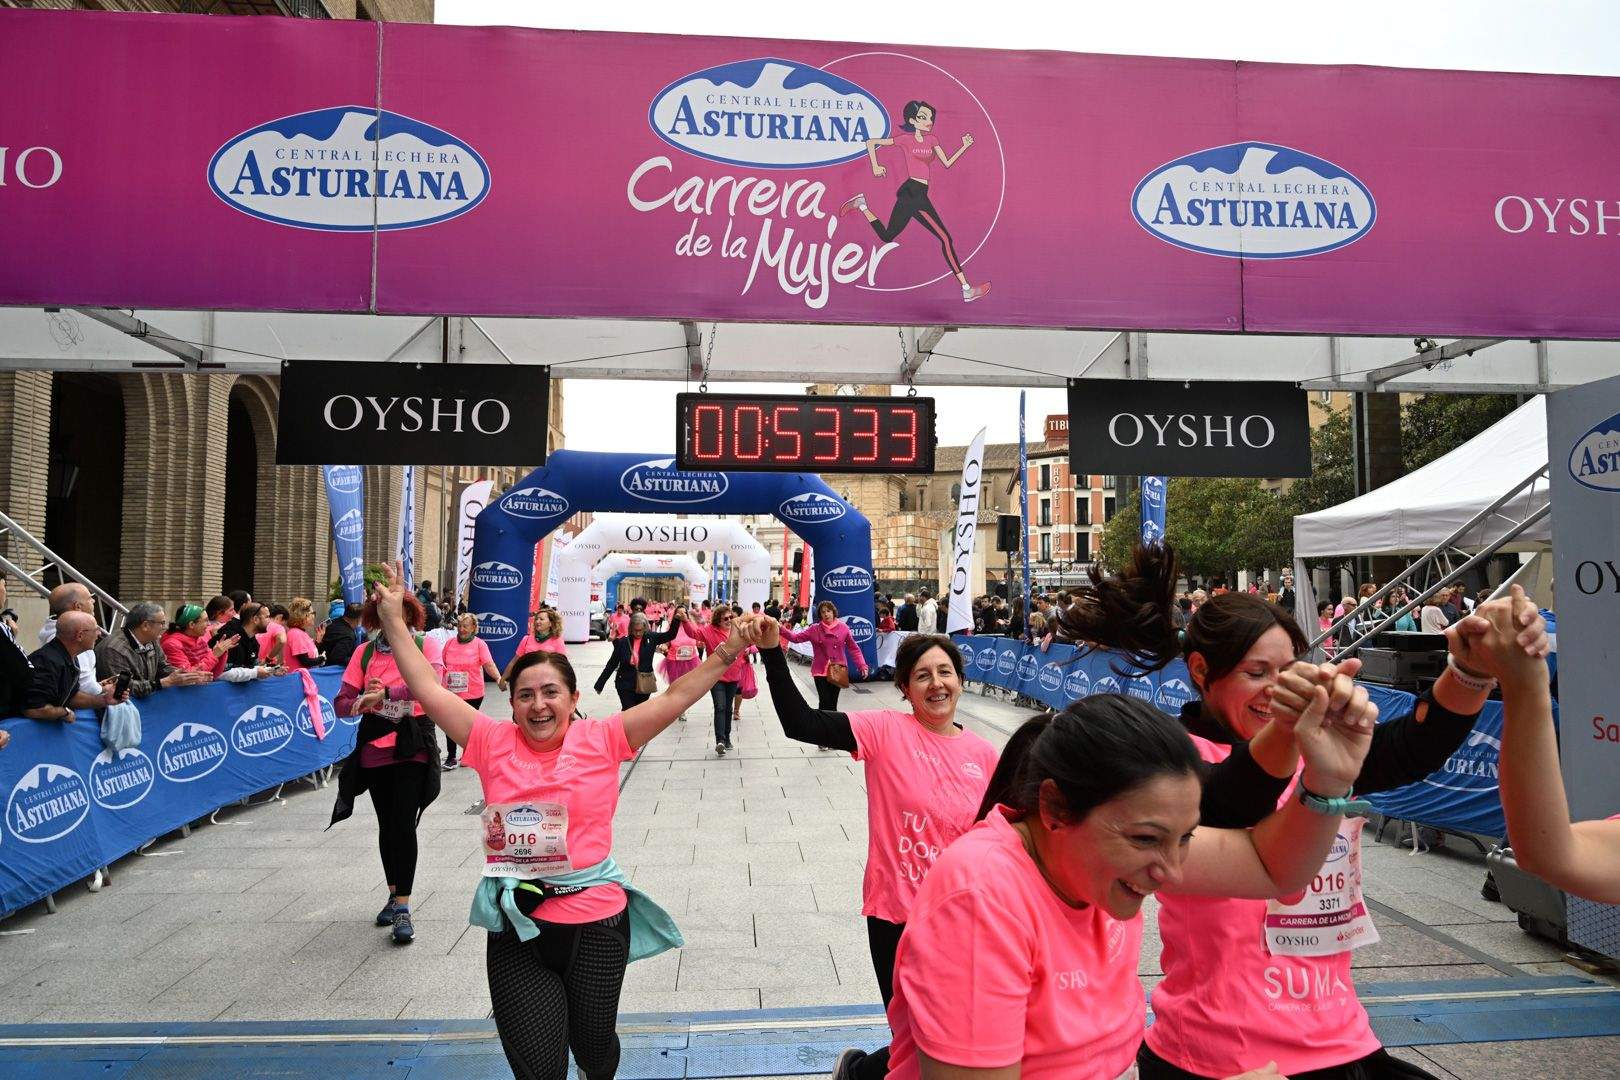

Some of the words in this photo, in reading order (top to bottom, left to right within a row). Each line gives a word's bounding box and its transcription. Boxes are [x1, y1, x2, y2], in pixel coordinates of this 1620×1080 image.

[706, 93, 783, 108] CENTRAL
[790, 97, 866, 111] LECHERA
[668, 94, 871, 143] ASTURIANA
[275, 147, 363, 162] CENTRAL
[371, 149, 461, 164] LECHERA
[229, 149, 469, 201] ASTURIANA
[627, 156, 826, 219] Carrera
[1189, 181, 1265, 194] CENTRAL
[1273, 183, 1350, 196] LECHERA
[1151, 182, 1359, 230] ASTURIANA
[676, 218, 712, 257] de
[721, 219, 747, 259] la
[741, 214, 900, 309] Mujer
[323, 394, 511, 435] OYSHO
[1048, 420, 1069, 431] TIB
[1108, 413, 1276, 448] OYSHO
[628, 471, 721, 493] ASTURIANA
[503, 497, 563, 512] ASTURIANA
[785, 504, 842, 516] ASTURIANA
[625, 525, 708, 543] OYSHO
[953, 459, 980, 596] OYSHO
[473, 573, 519, 585] ASTURIANA
[825, 576, 870, 588] ASTURIANA
[852, 628, 872, 637] RIANA
[238, 723, 291, 749] ASTURIANA
[164, 742, 224, 774] ASTURIANA
[24, 789, 53, 805] CENTRAL
[53, 779, 79, 794] LECHERA
[95, 766, 152, 799] ASTURIANA
[15, 788, 88, 833] ASTURIANA
[902, 810, 927, 833] TU
[508, 833, 537, 845] 016
[1310, 872, 1345, 893] 016
[1319, 899, 1340, 911] 3371
[1280, 916, 1318, 926] CARRERA
[1318, 916, 1328, 925] DE
[1275, 935, 1319, 945] OYSHO
[1263, 965, 1349, 999] SUMA
